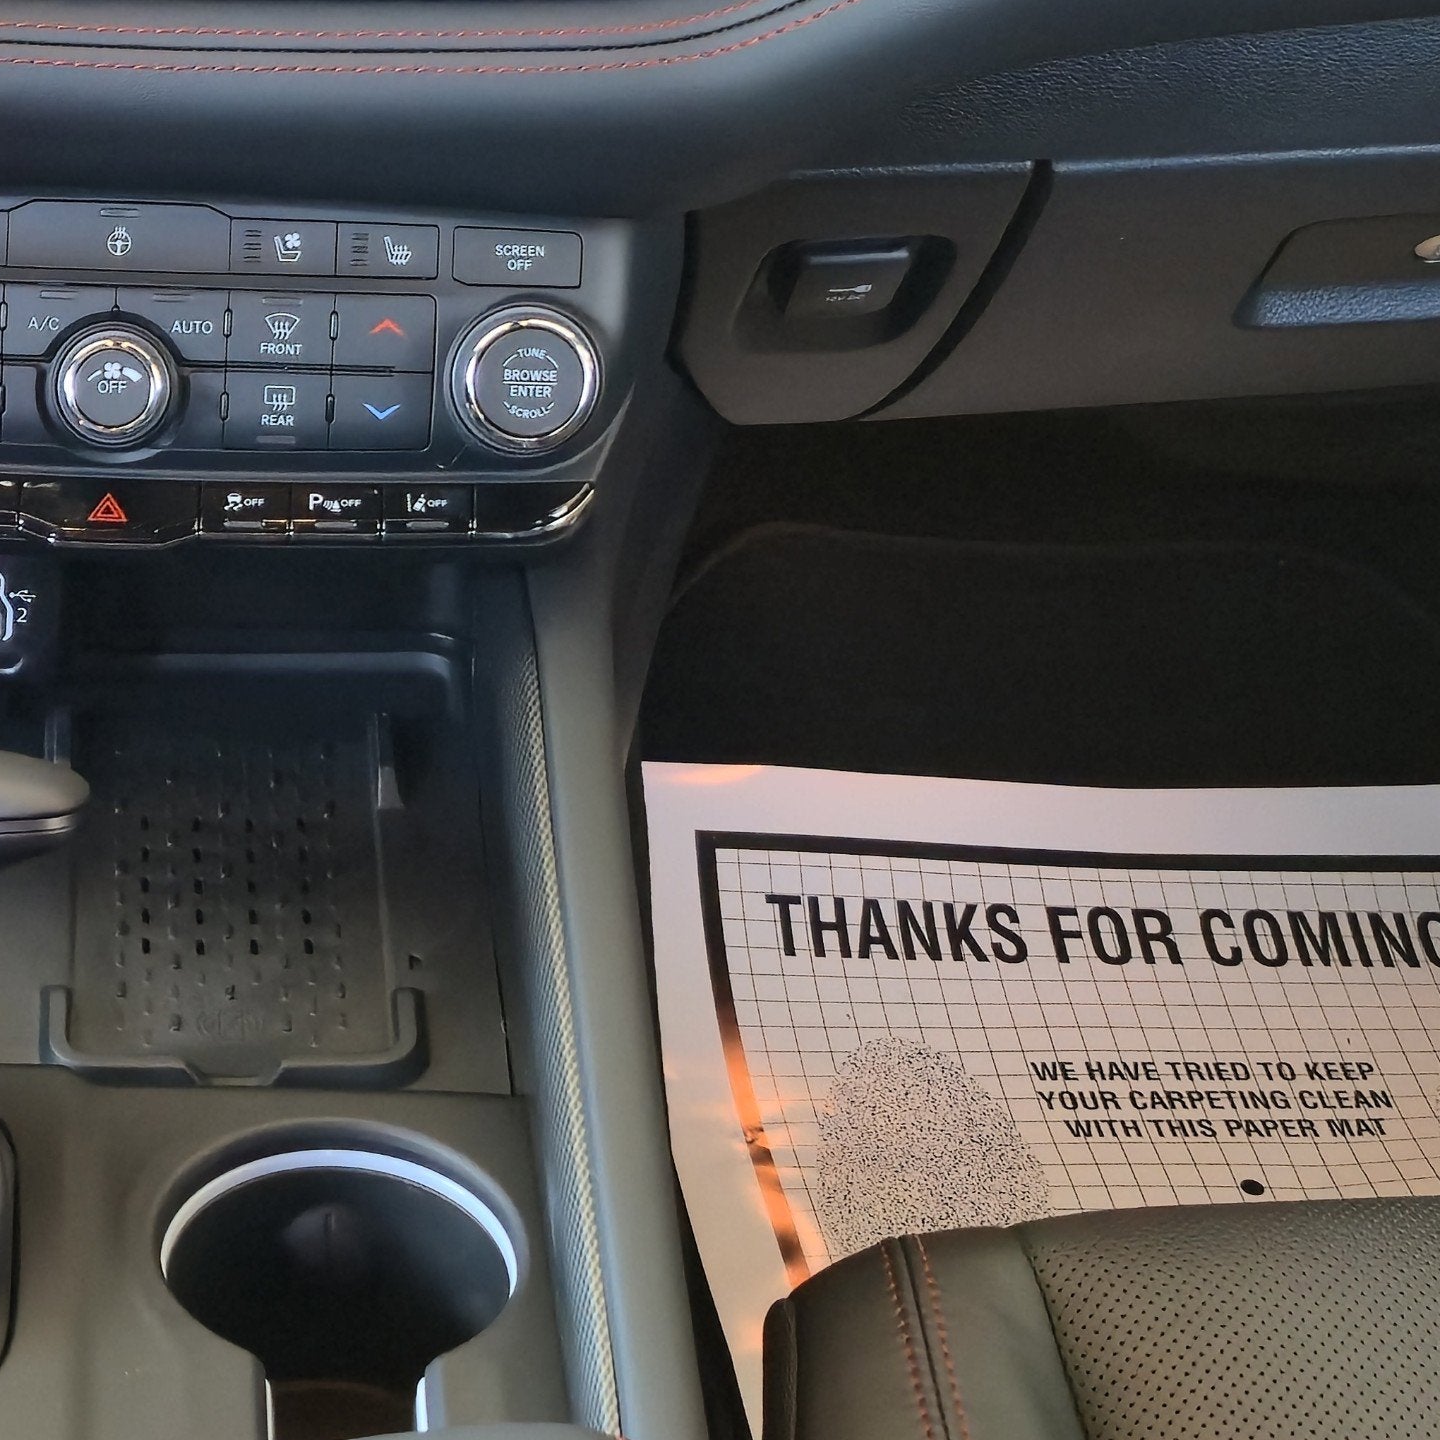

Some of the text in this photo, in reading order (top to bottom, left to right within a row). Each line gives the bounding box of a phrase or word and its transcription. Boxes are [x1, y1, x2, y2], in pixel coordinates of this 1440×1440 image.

[494, 244, 545, 258] SCREEN
[507, 259, 533, 271] OFF
[27, 316, 60, 333] A/C
[171, 319, 214, 335] AUTO
[260, 342, 302, 357] FRONT
[517, 347, 547, 360] TUNE
[503, 368, 558, 382] BROWSE
[96, 380, 128, 395] OFF
[510, 385, 552, 398] ENTER
[508, 405, 550, 419] SCROLL
[261, 413, 294, 427] REAR
[243, 498, 265, 507] OFF
[340, 498, 362, 508] OFF
[427, 498, 448, 507] OFF
[16, 607, 28, 623] 2
[764, 892, 1028, 965] THANKS
[1046, 905, 1182, 967] FOR
[1030, 1060, 1375, 1081] WE HAVE TRIED TO KEEP
[1037, 1089, 1394, 1111] YOUR CARPETING CLEAN
[1063, 1118, 1387, 1138] WITH THIS PAPER MAT
